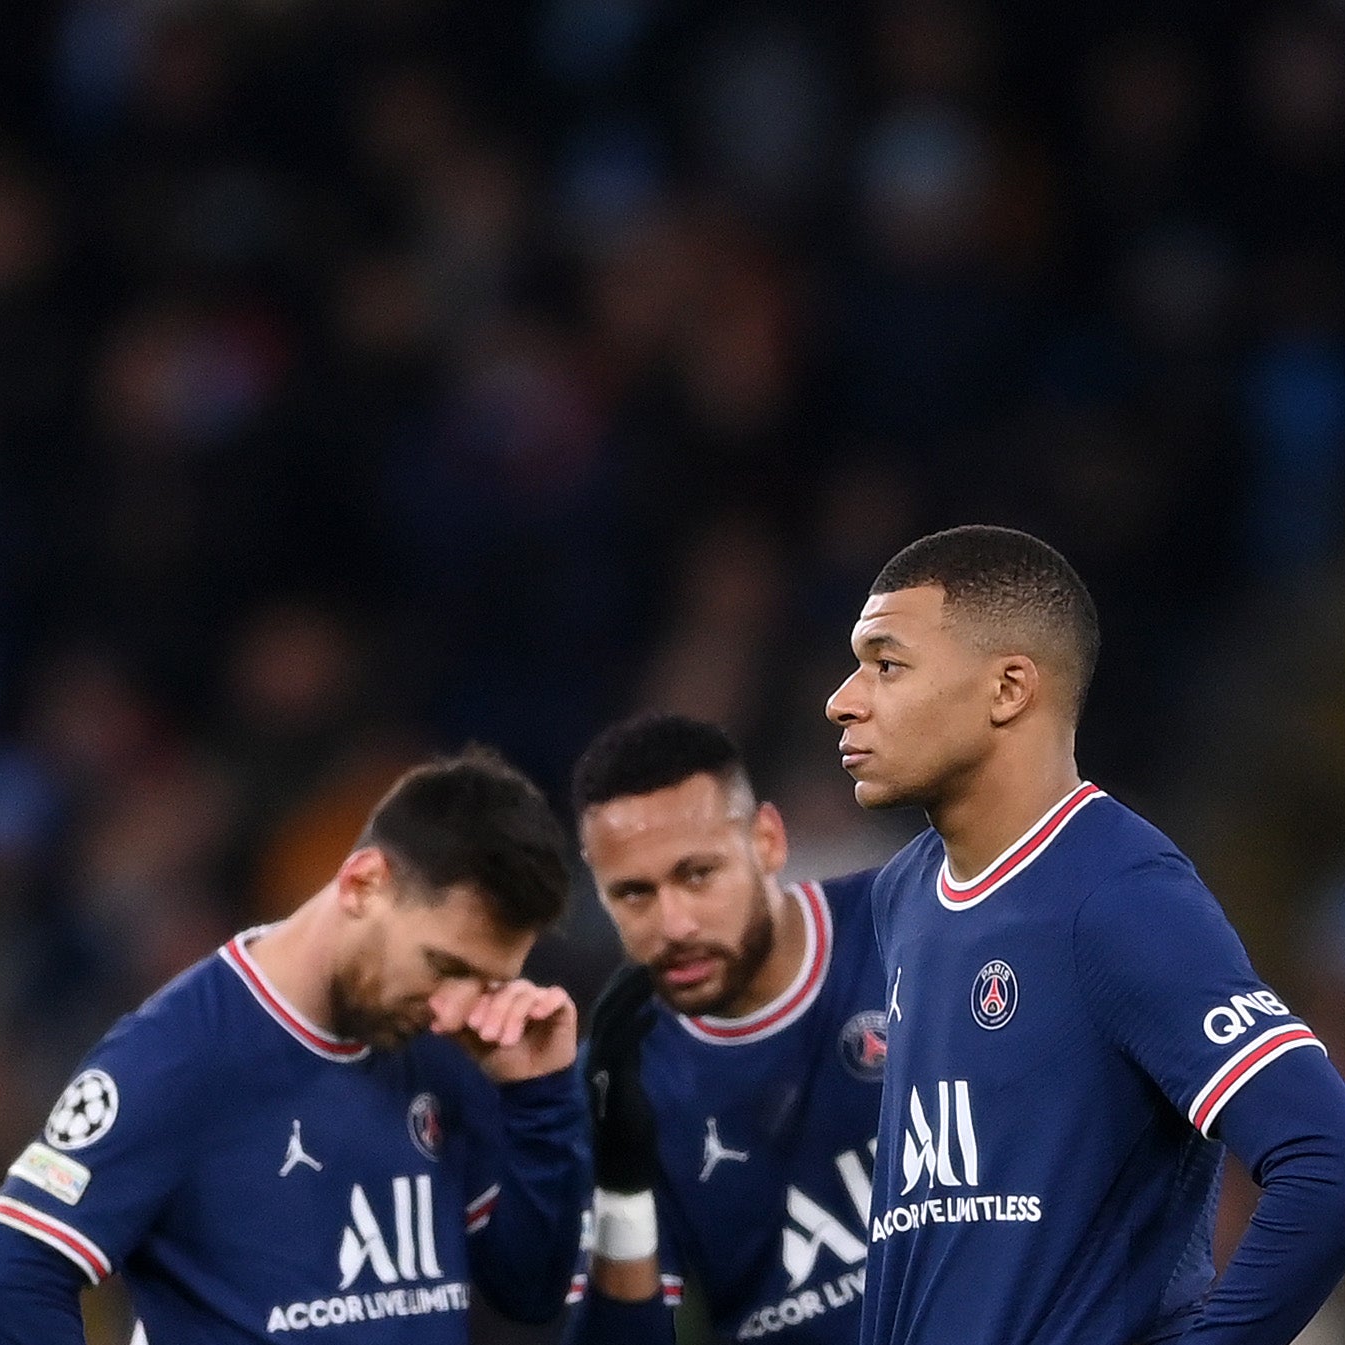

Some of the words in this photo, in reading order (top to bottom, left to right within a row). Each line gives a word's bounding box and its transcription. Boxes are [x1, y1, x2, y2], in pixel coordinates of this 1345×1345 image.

[981, 963, 1011, 981] PARIS
[1203, 990, 1291, 1045] QNB
[266, 1295, 365, 1333] ACCOR
